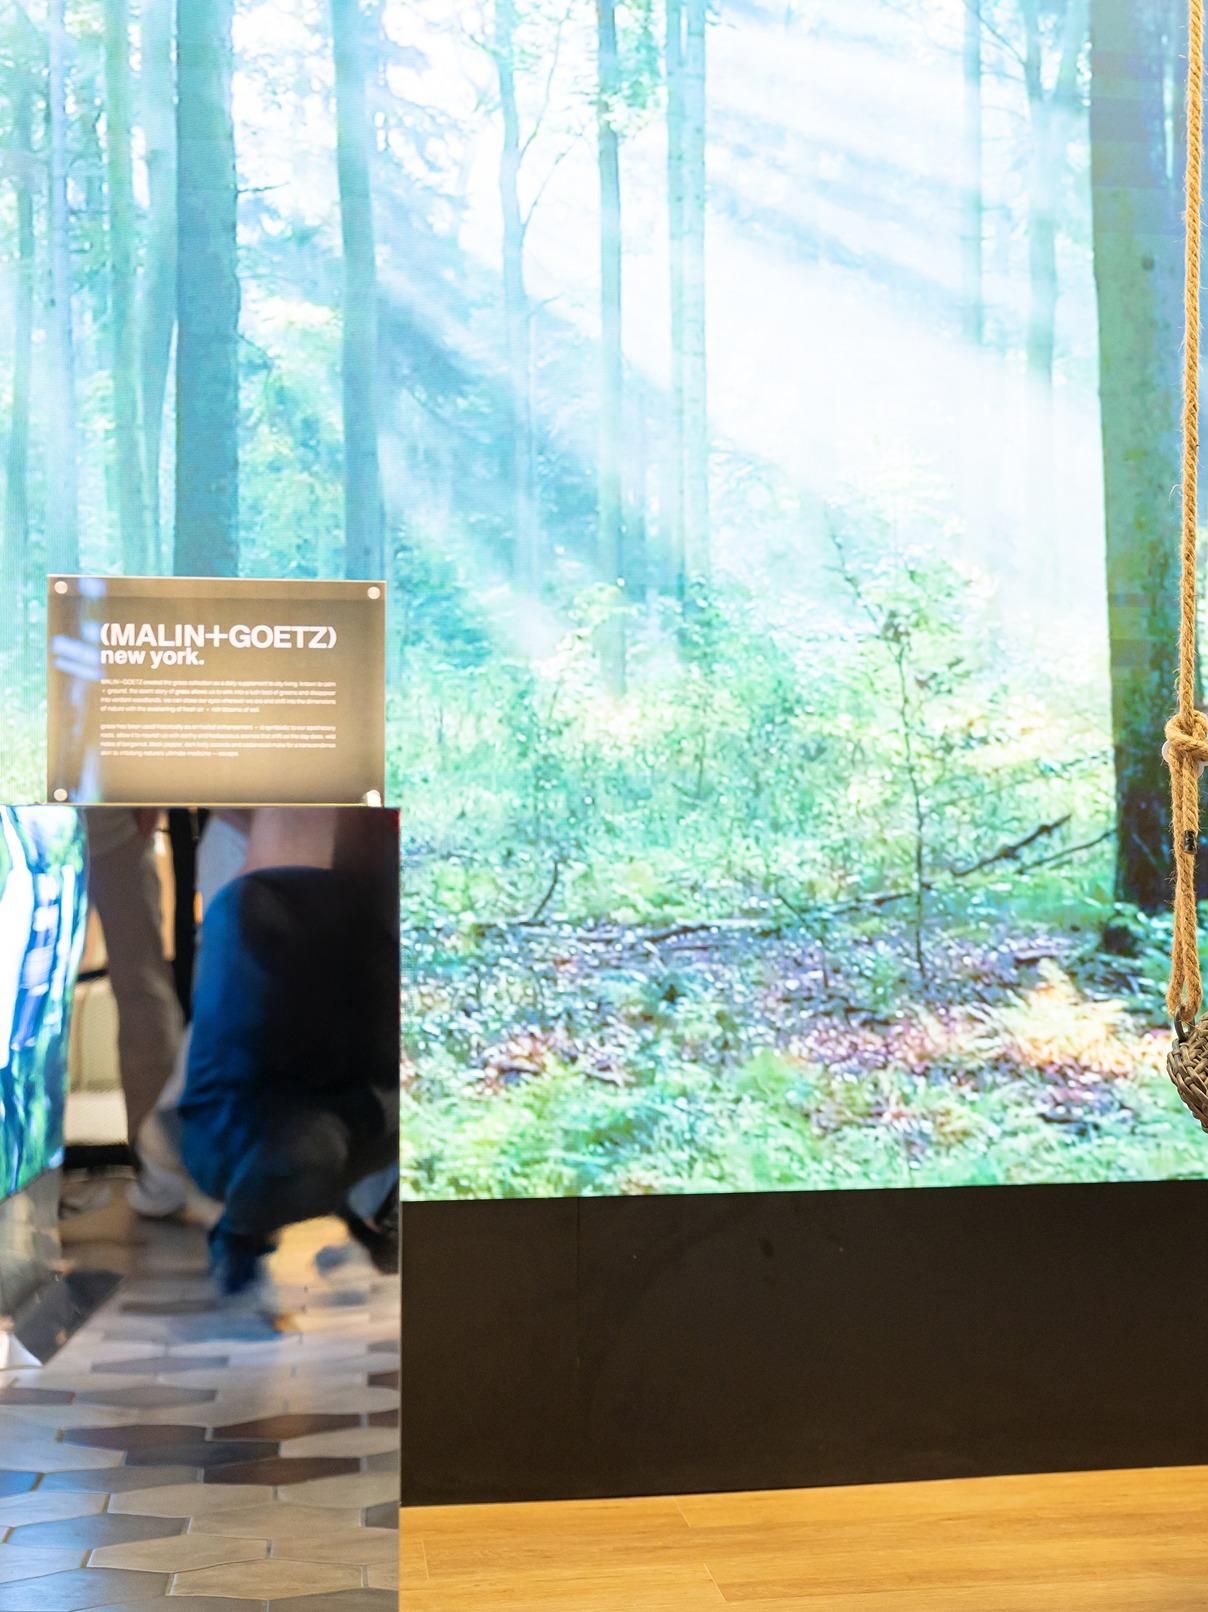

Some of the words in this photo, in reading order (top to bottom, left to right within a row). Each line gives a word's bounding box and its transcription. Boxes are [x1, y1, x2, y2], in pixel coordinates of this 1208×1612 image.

[100, 623, 337, 649] (MALIN+GOETZ)
[100, 649, 146, 665] new
[151, 648, 205, 670] york.
